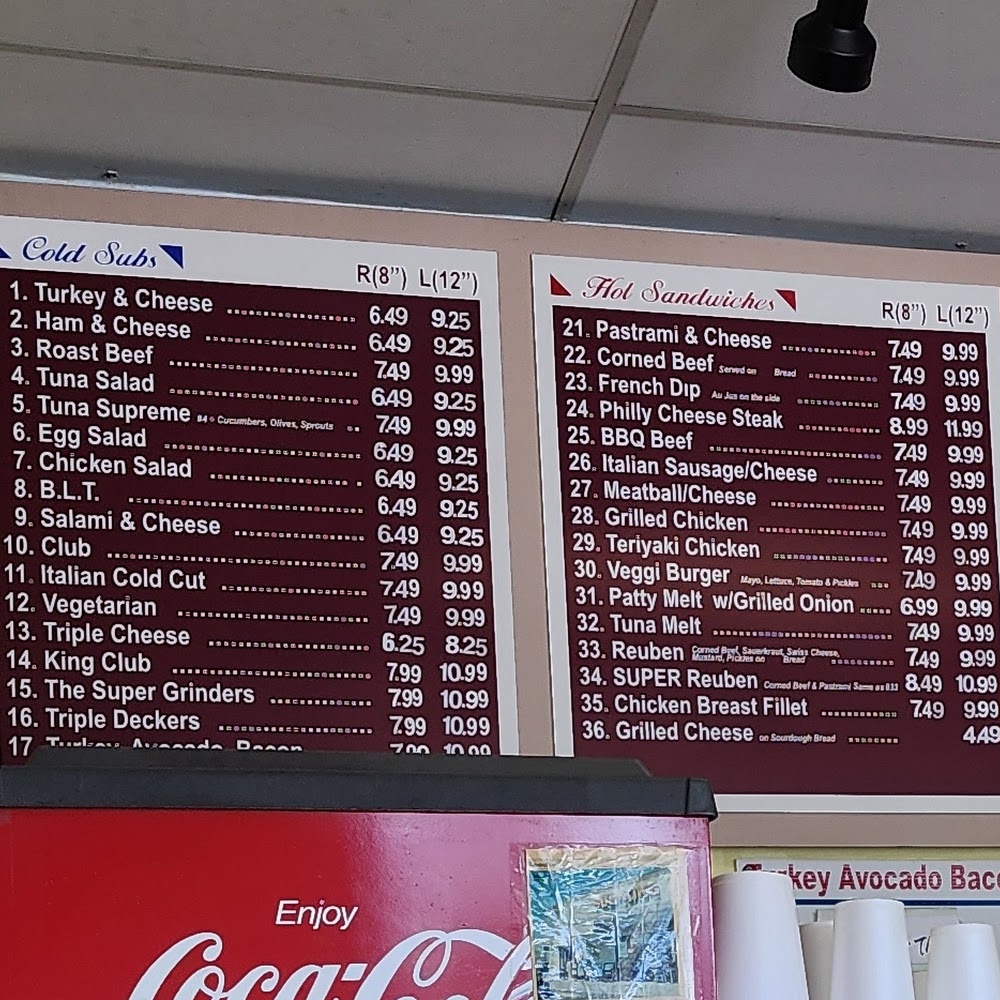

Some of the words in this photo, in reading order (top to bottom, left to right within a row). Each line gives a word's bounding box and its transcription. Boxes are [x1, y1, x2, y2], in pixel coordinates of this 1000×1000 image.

[21, 236, 87, 264] Cold
[93, 241, 157, 269] Subs
[10, 281, 27, 300] 1.
[34, 282, 106, 310] Turkey
[114, 288, 128, 306] &
[135, 289, 212, 312] Cheese
[370, 306, 408, 325] 6.49
[431, 309, 470, 330] 9.25
[582, 275, 633, 300] Hot
[641, 280, 775, 310] Sandwiches
[563, 318, 590, 337] 21.
[597, 320, 678, 343] Pastrami
[685, 326, 698, 344] &
[704, 328, 771, 349] Cheese
[888, 340, 921, 359] 7.49
[943, 343, 978, 361] 9.99
[564, 345, 591, 364] 22.
[598, 347, 665, 369] Corned
[672, 352, 714, 371] Beef
[774, 368, 796, 377] Bread
[889, 365, 925, 384] 7.49
[944, 369, 979, 387] 9.99
[13, 394, 30, 413] 5.
[37, 395, 89, 416] Tuna
[97, 398, 190, 423] Supreme
[376, 415, 411, 435] 7.49
[436, 419, 476, 437] 9.99
[7, 678, 37, 698] 15.
[44, 679, 85, 699] The
[93, 680, 156, 705] Super
[163, 682, 254, 703] Grinders
[388, 688, 422, 708] 7.99
[441, 690, 489, 709] 10.99
[583, 721, 610, 739] 36.
[616, 721, 678, 740] Grilled
[685, 722, 753, 741] Cheese
[814, 734, 836, 742] Bread
[839, 864, 942, 891] Avocado
[275, 899, 357, 930] Enjoy
